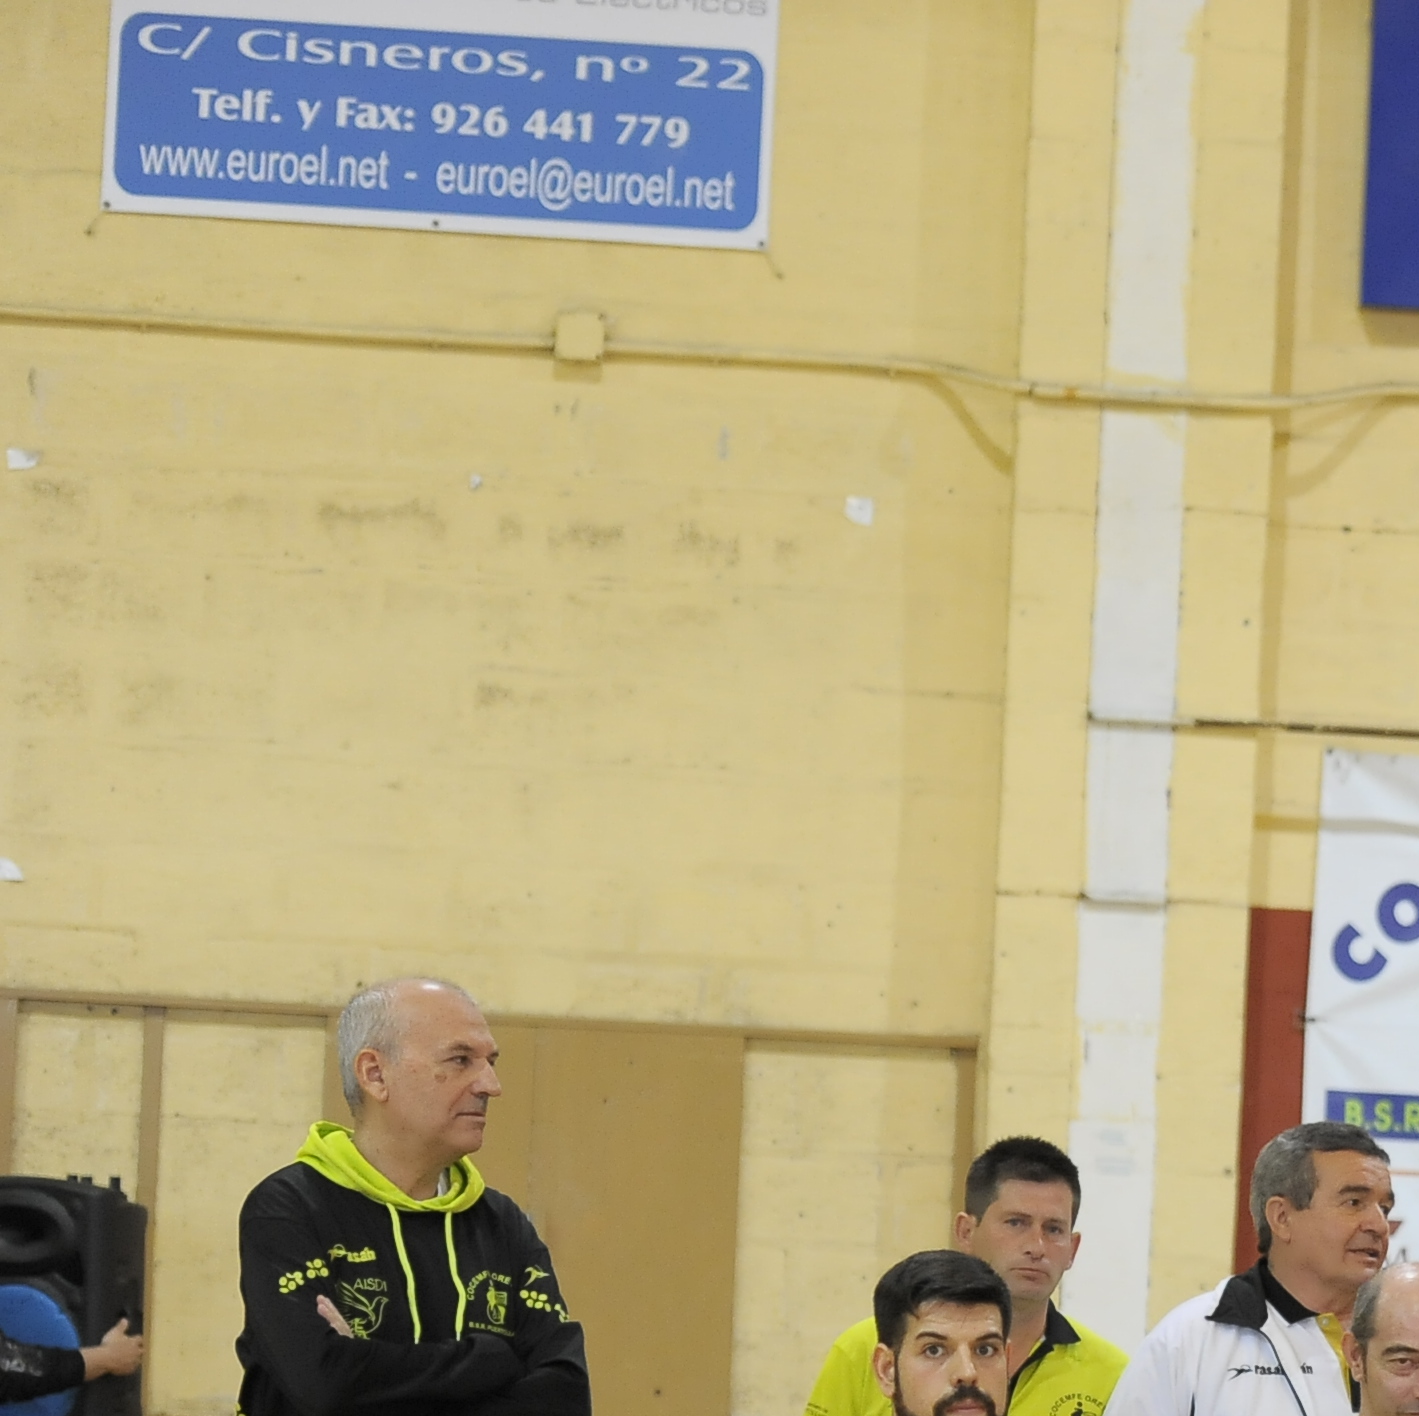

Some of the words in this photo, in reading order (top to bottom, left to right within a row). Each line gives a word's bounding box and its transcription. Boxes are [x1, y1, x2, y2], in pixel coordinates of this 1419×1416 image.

[137, 22, 209, 60] C/
[236, 29, 547, 84] Cisneros,
[675, 57, 753, 92] 22
[191, 87, 283, 126] Telf.
[297, 98, 322, 131] y
[335, 95, 416, 134] Fax:
[431, 103, 509, 139] 926
[523, 108, 595, 145] 441
[615, 112, 691, 150] 779
[139, 139, 390, 193] www.euroel.net
[435, 156, 736, 213] euroel@euroel.net
